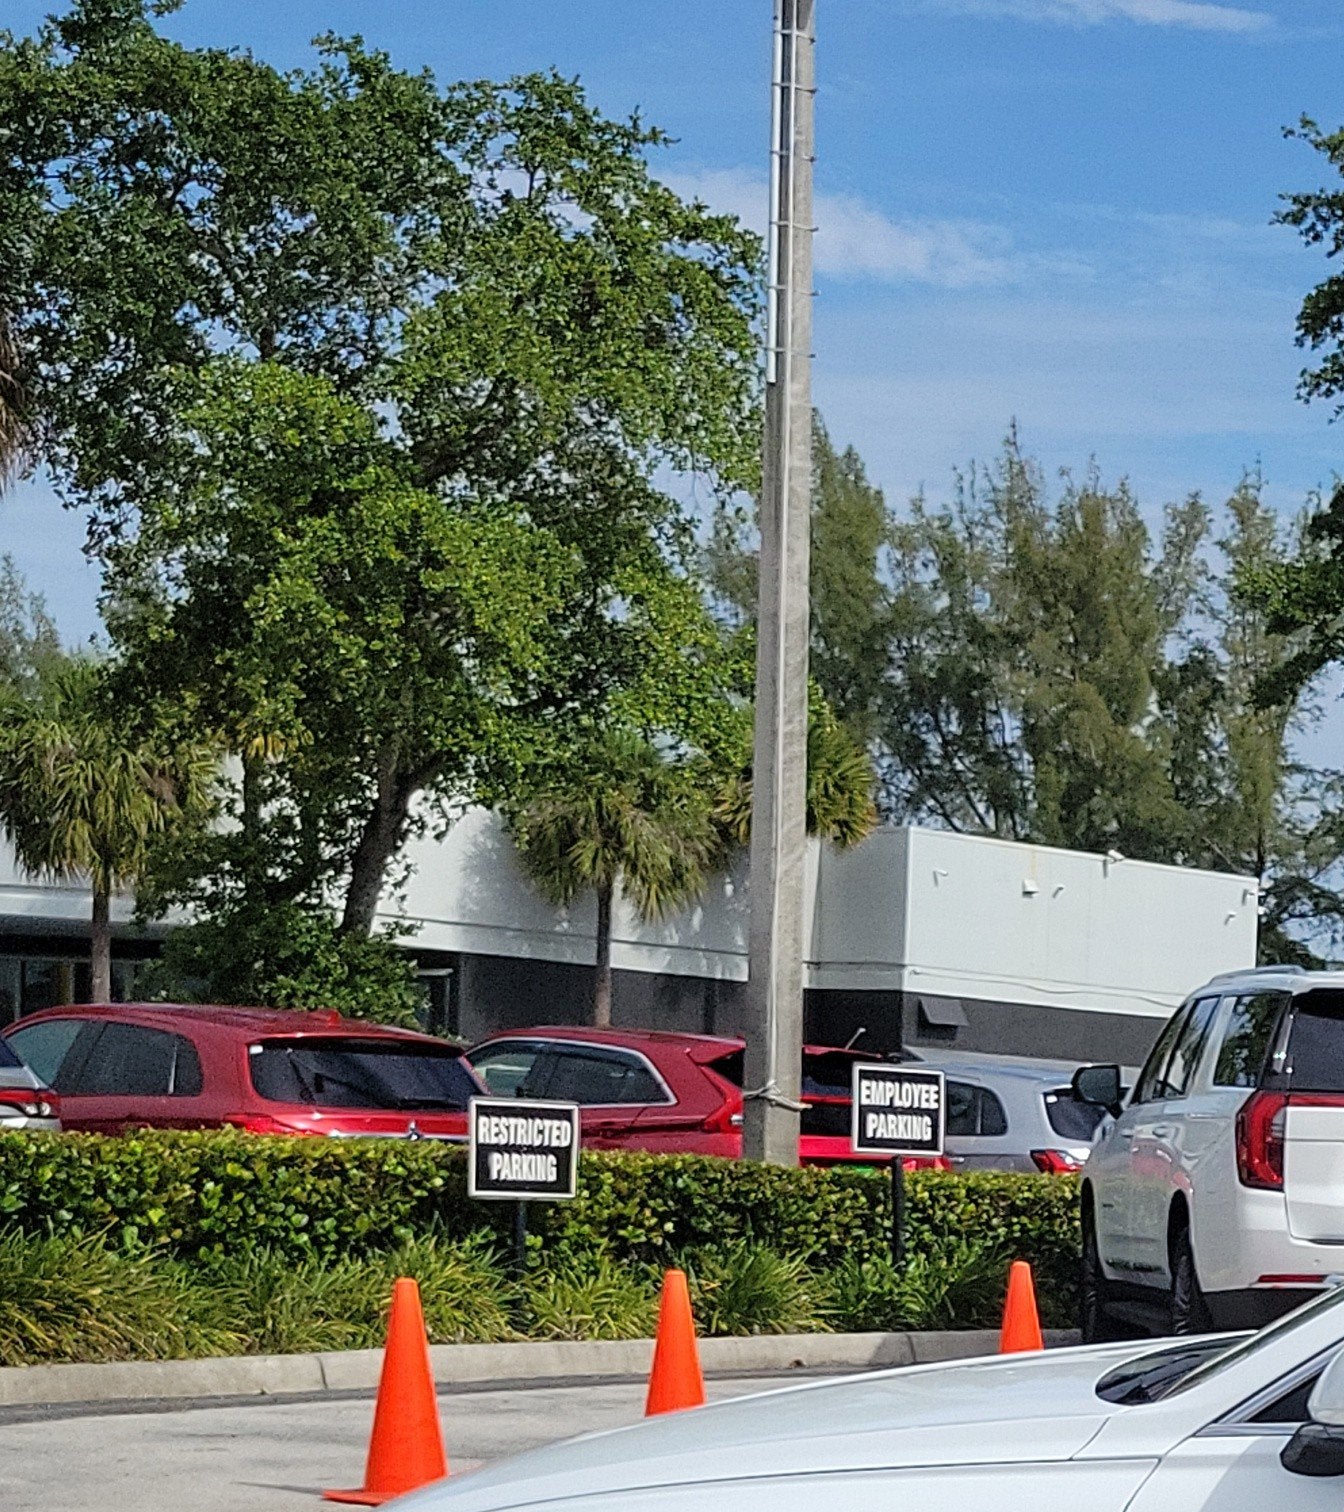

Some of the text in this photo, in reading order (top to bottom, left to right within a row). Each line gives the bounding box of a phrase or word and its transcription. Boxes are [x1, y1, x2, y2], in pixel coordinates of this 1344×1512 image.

[860, 1079, 940, 1109] EMPLOYEE
[478, 1115, 572, 1148] RESTRICTED
[866, 1112, 933, 1141] PARKING
[488, 1151, 557, 1182] PARKING
